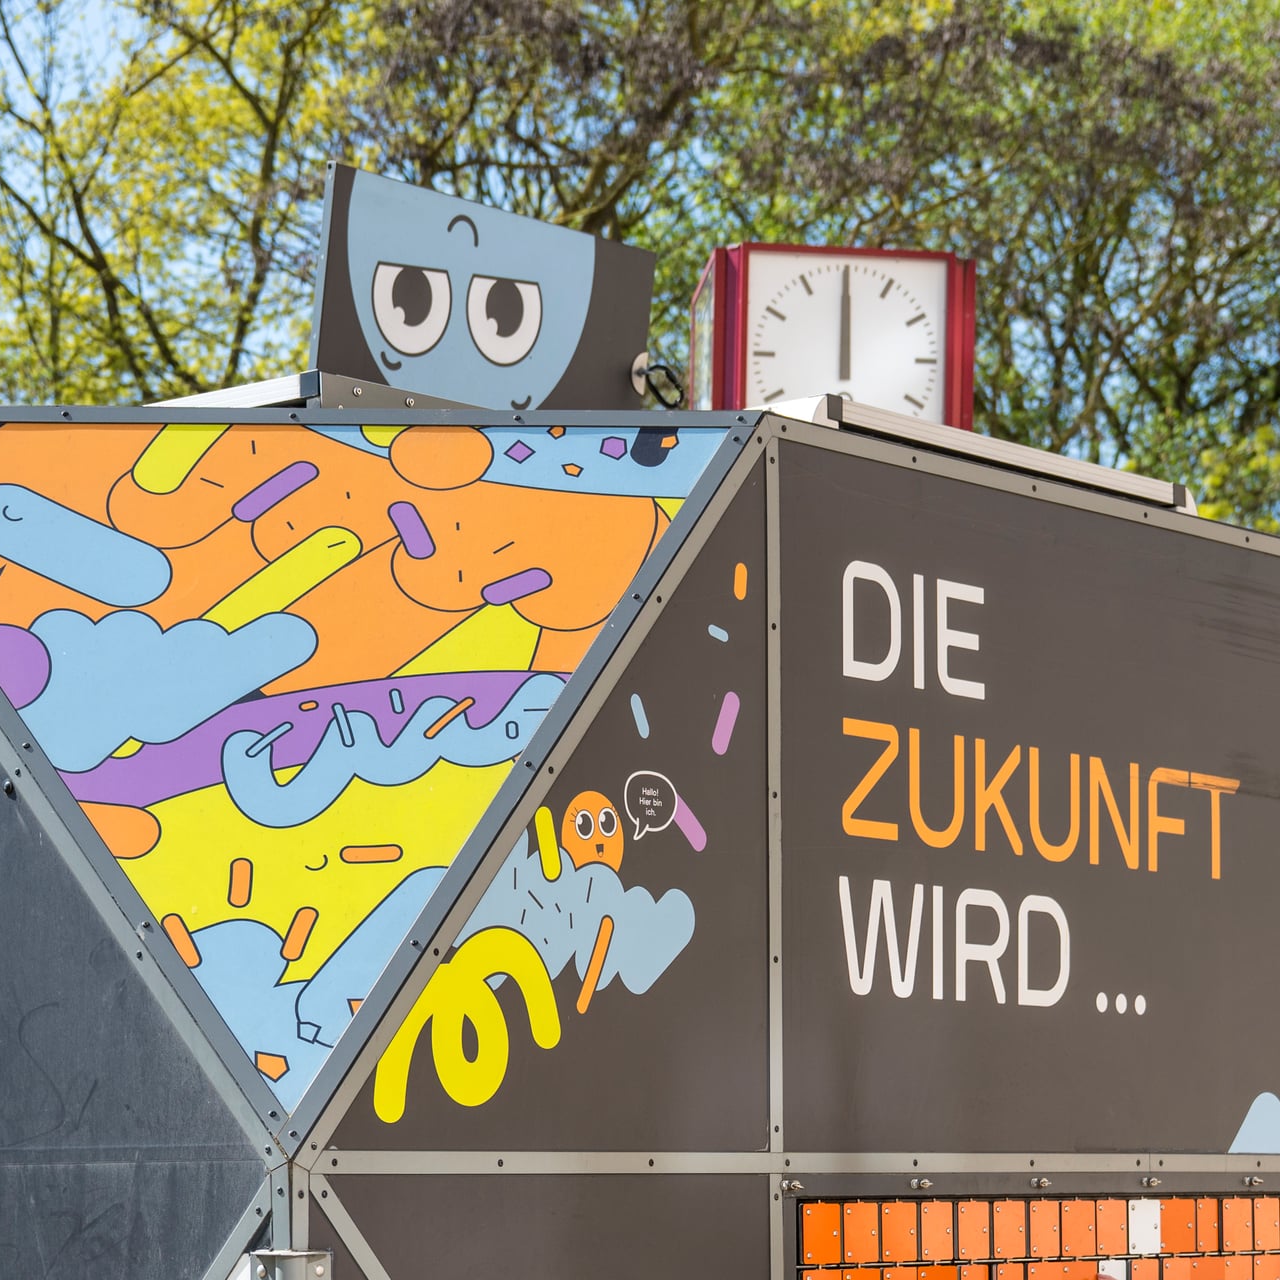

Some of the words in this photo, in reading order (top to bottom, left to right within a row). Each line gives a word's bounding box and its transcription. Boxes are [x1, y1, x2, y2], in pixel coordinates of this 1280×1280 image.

[842, 560, 985, 700] DIE
[639, 797, 651, 807] Hier
[652, 798, 663, 807] bin
[641, 787, 659, 797] Hallo!
[645, 808, 657, 817] ich.
[842, 717, 1240, 880] ZUKUNFT
[839, 876, 1070, 1007] WIRD
